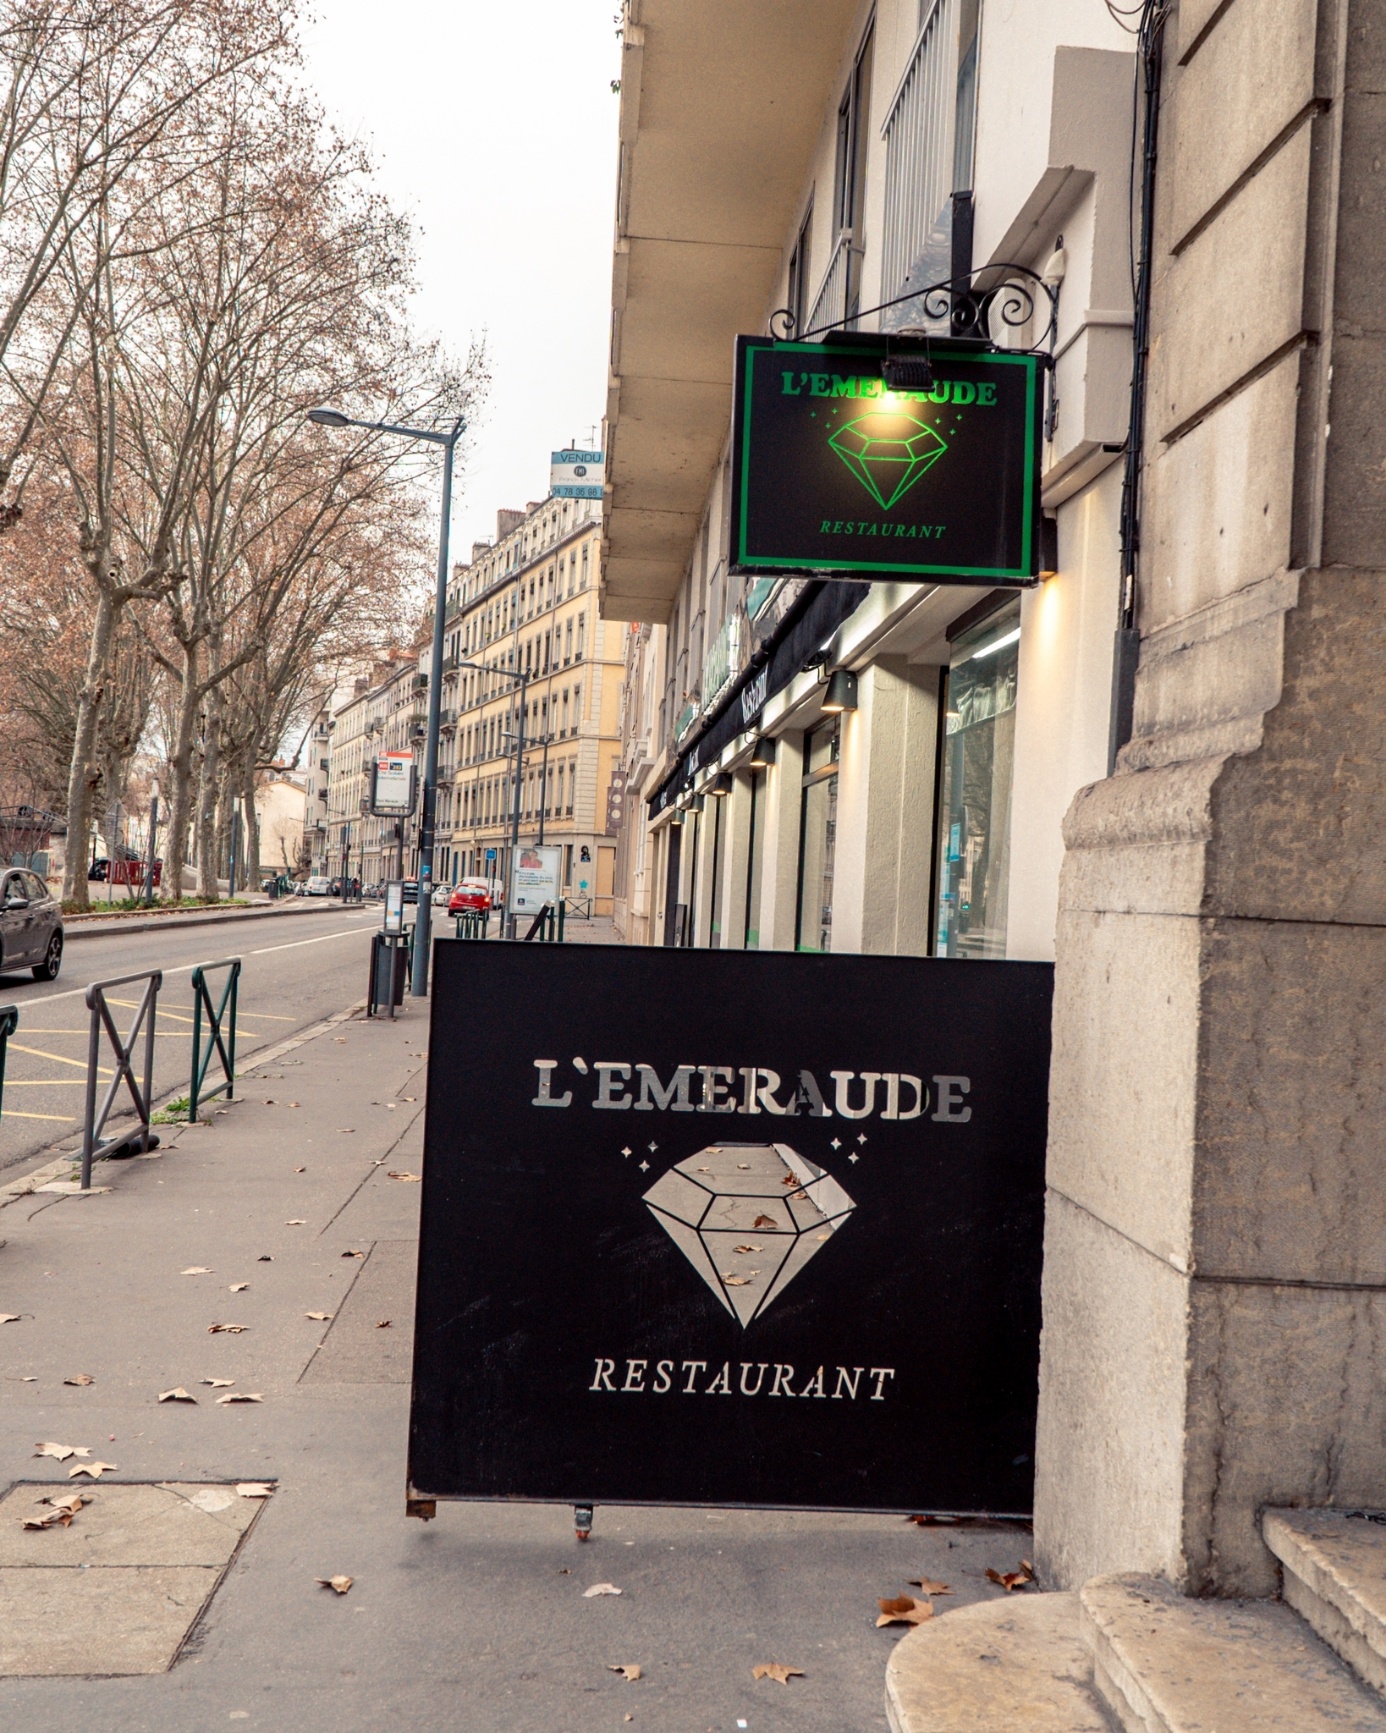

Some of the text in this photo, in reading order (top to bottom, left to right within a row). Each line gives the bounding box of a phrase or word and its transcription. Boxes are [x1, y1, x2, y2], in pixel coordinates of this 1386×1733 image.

[781, 371, 998, 406] L'EMEUDE
[560, 453, 601, 463] VENDU
[564, 488, 573, 496] 78
[819, 520, 946, 539] RESTAURANT
[588, 1358, 896, 1401] RESTAURANT
